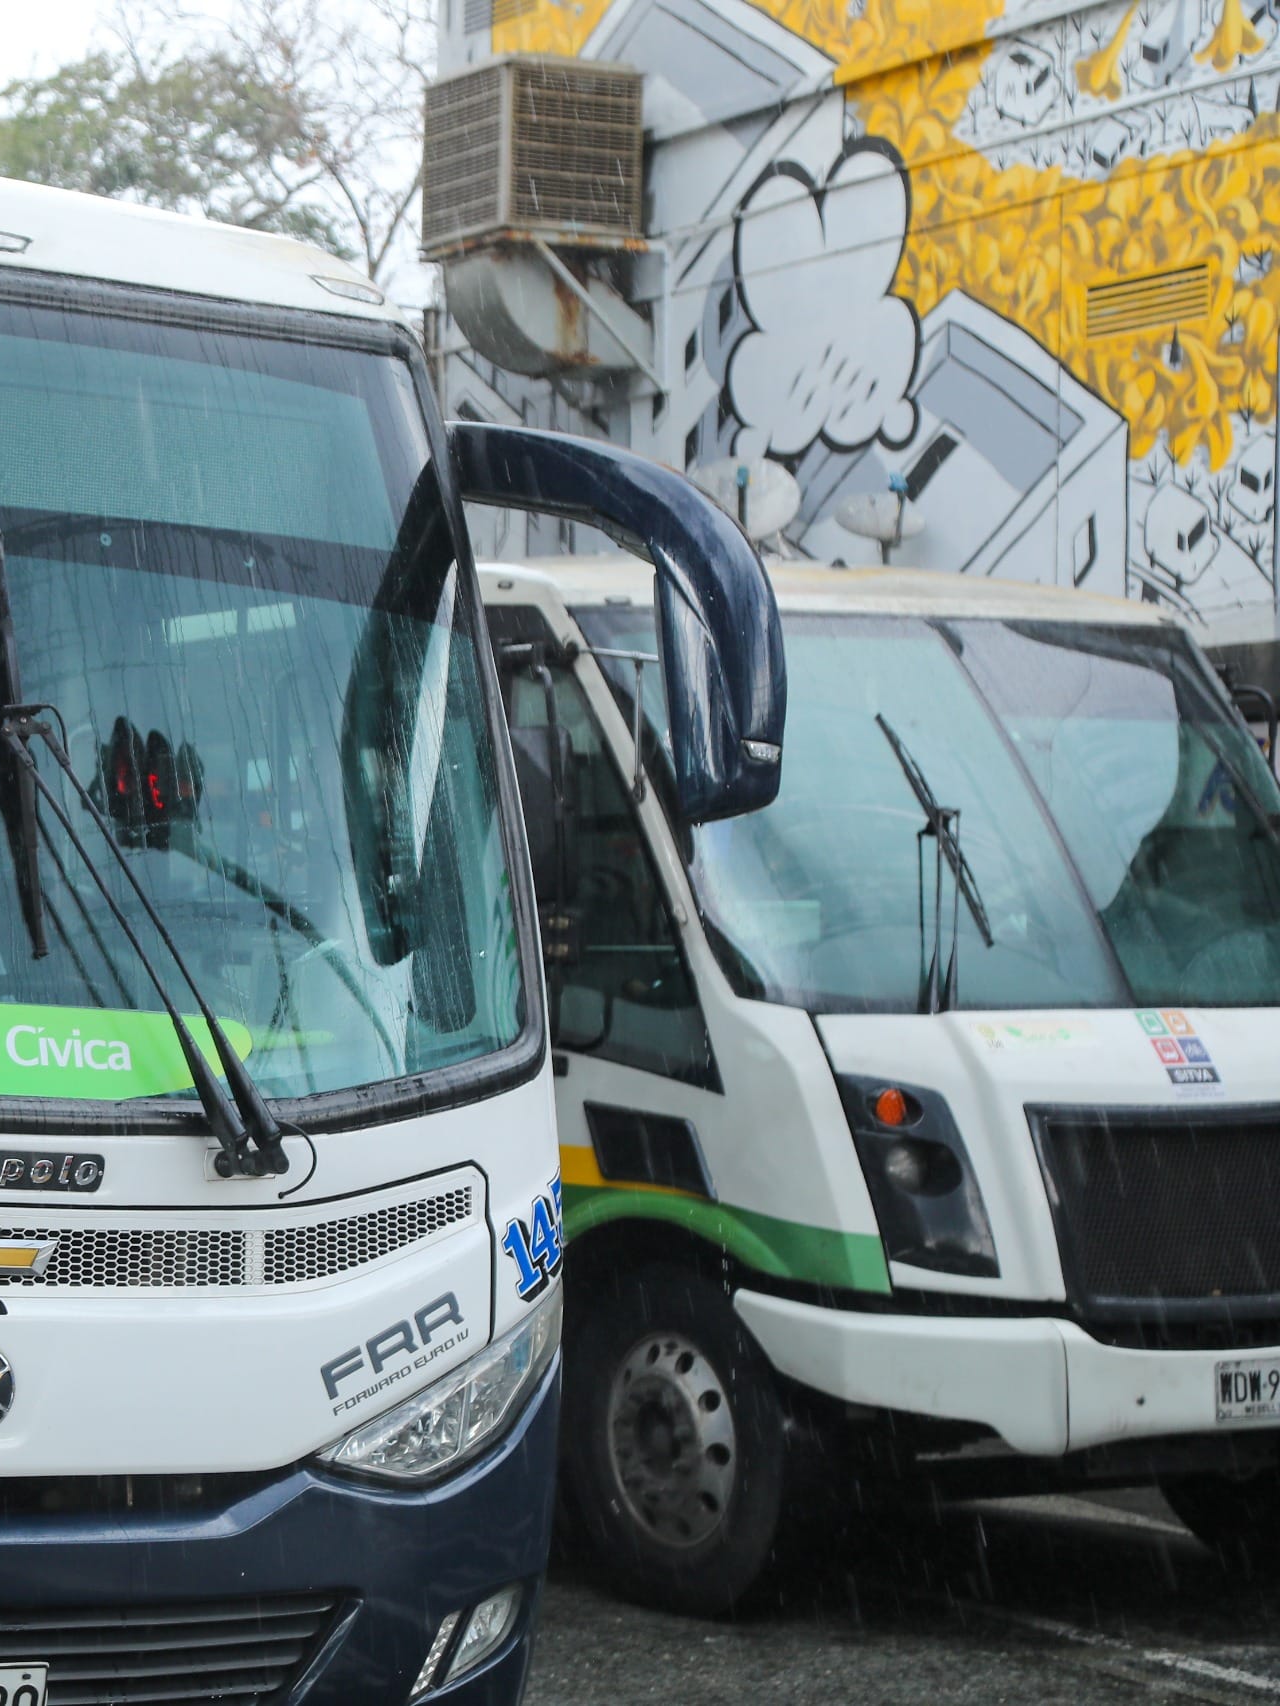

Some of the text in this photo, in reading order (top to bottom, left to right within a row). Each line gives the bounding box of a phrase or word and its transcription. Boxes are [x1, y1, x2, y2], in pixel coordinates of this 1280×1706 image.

[5, 1024, 132, 1071] Cívica
[320, 1290, 465, 1401] FRR
[332, 1364, 412, 1416] FORWARD
[414, 1337, 456, 1370] EURO
